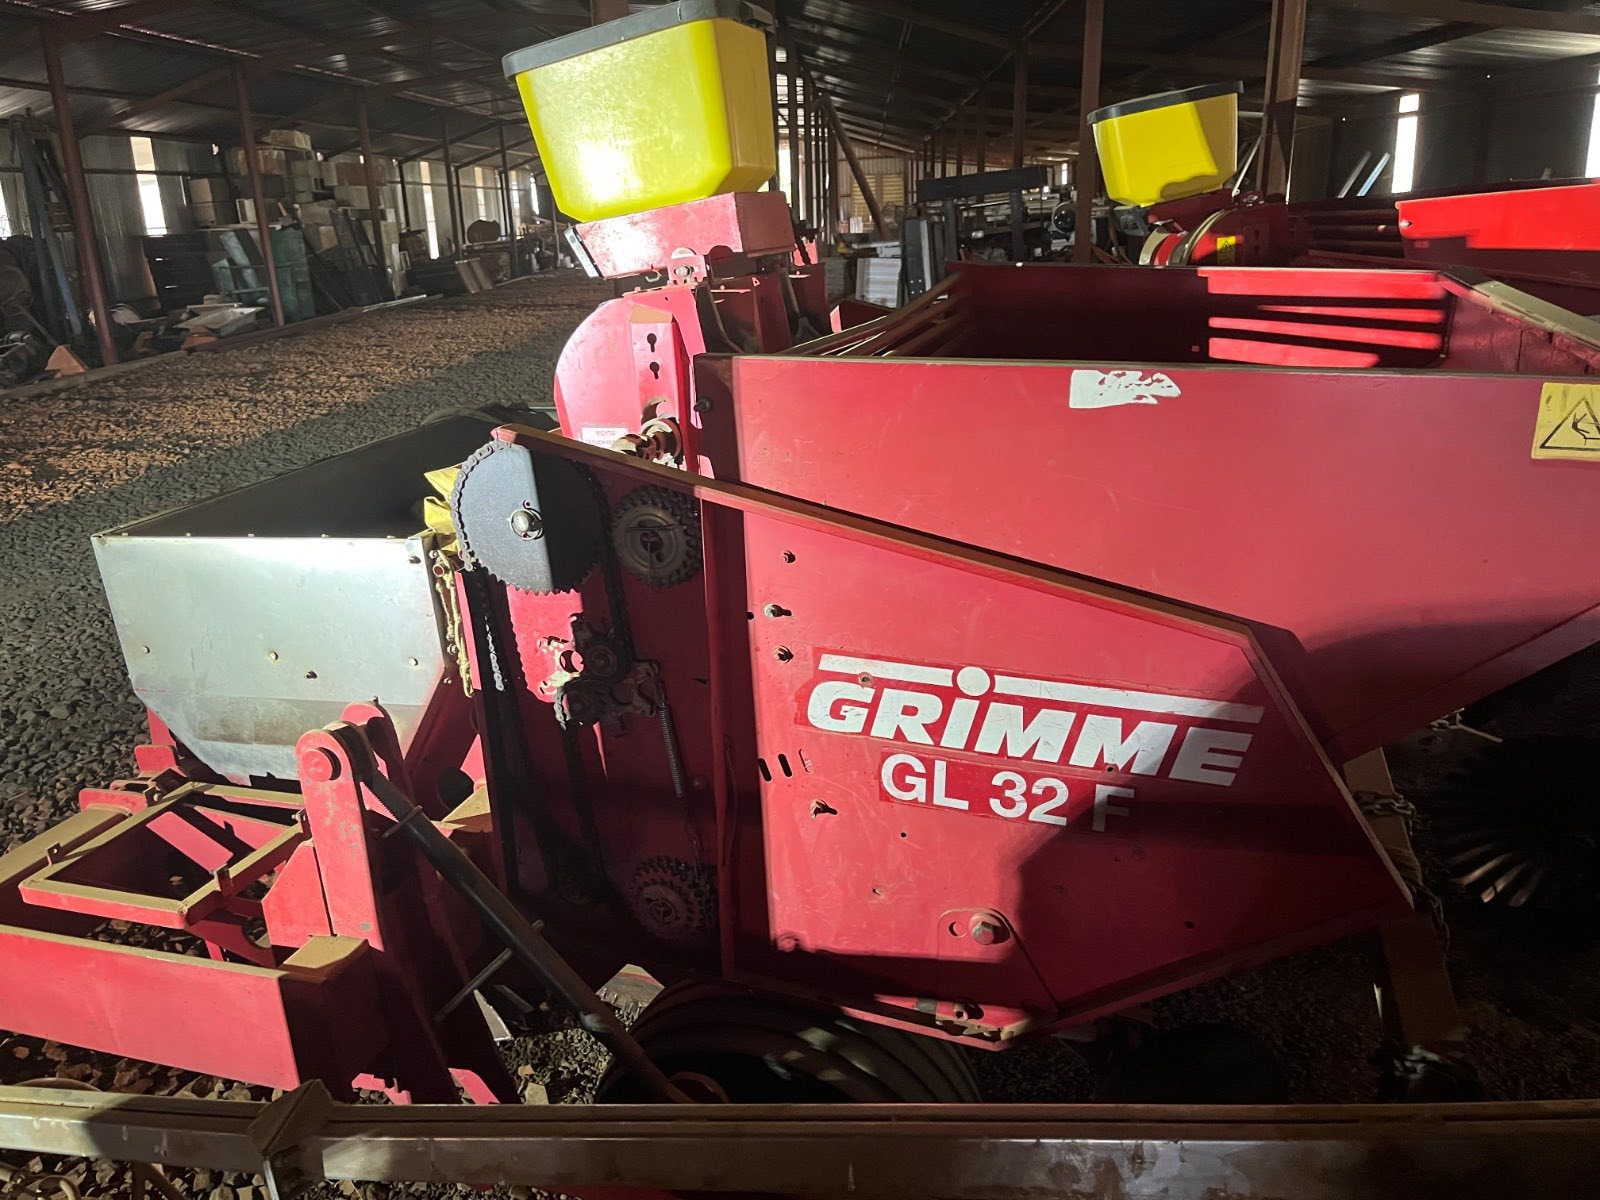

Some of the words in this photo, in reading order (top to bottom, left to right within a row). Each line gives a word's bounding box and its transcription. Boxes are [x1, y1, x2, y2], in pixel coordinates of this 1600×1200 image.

[807, 666, 1253, 787] GRIMME
[880, 753, 969, 811] GL
[989, 771, 1070, 827] 32
[1092, 783, 1135, 833] F
